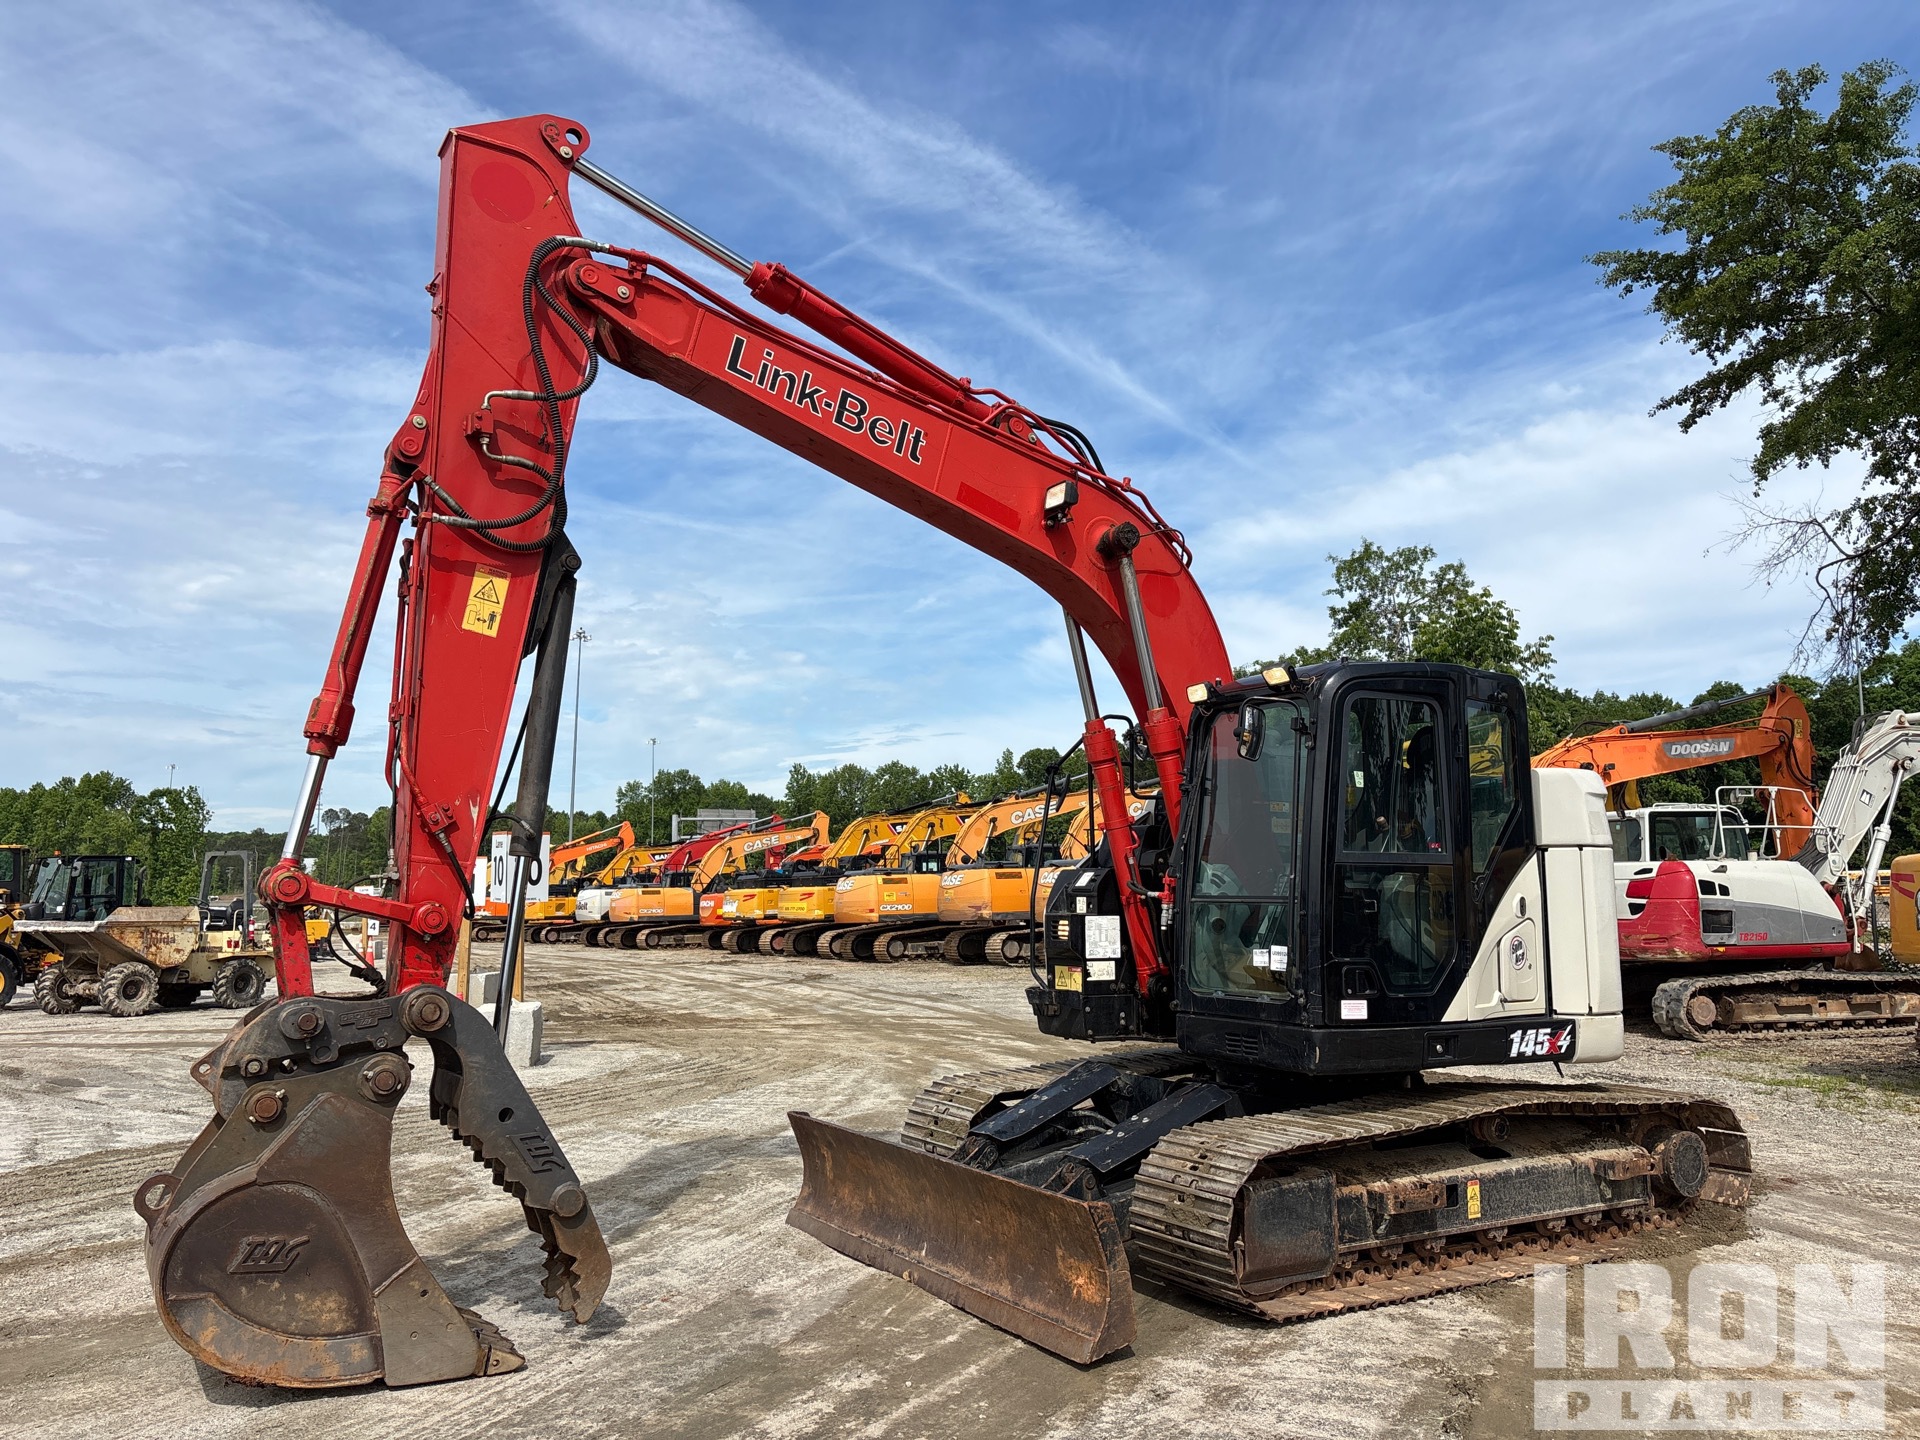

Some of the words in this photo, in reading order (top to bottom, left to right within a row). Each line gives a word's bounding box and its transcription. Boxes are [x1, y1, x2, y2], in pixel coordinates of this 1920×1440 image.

[725, 334, 926, 465] Link-Belt
[1671, 741, 1730, 756] DOOSAN
[1010, 799, 1057, 825] CASE
[586, 843, 608, 851] HITACHI
[743, 834, 780, 852] CASE
[493, 855, 504, 887] 10
[942, 874, 965, 886] CASE
[369, 922, 376, 930] 4
[1739, 932, 1768, 942] TB2150
